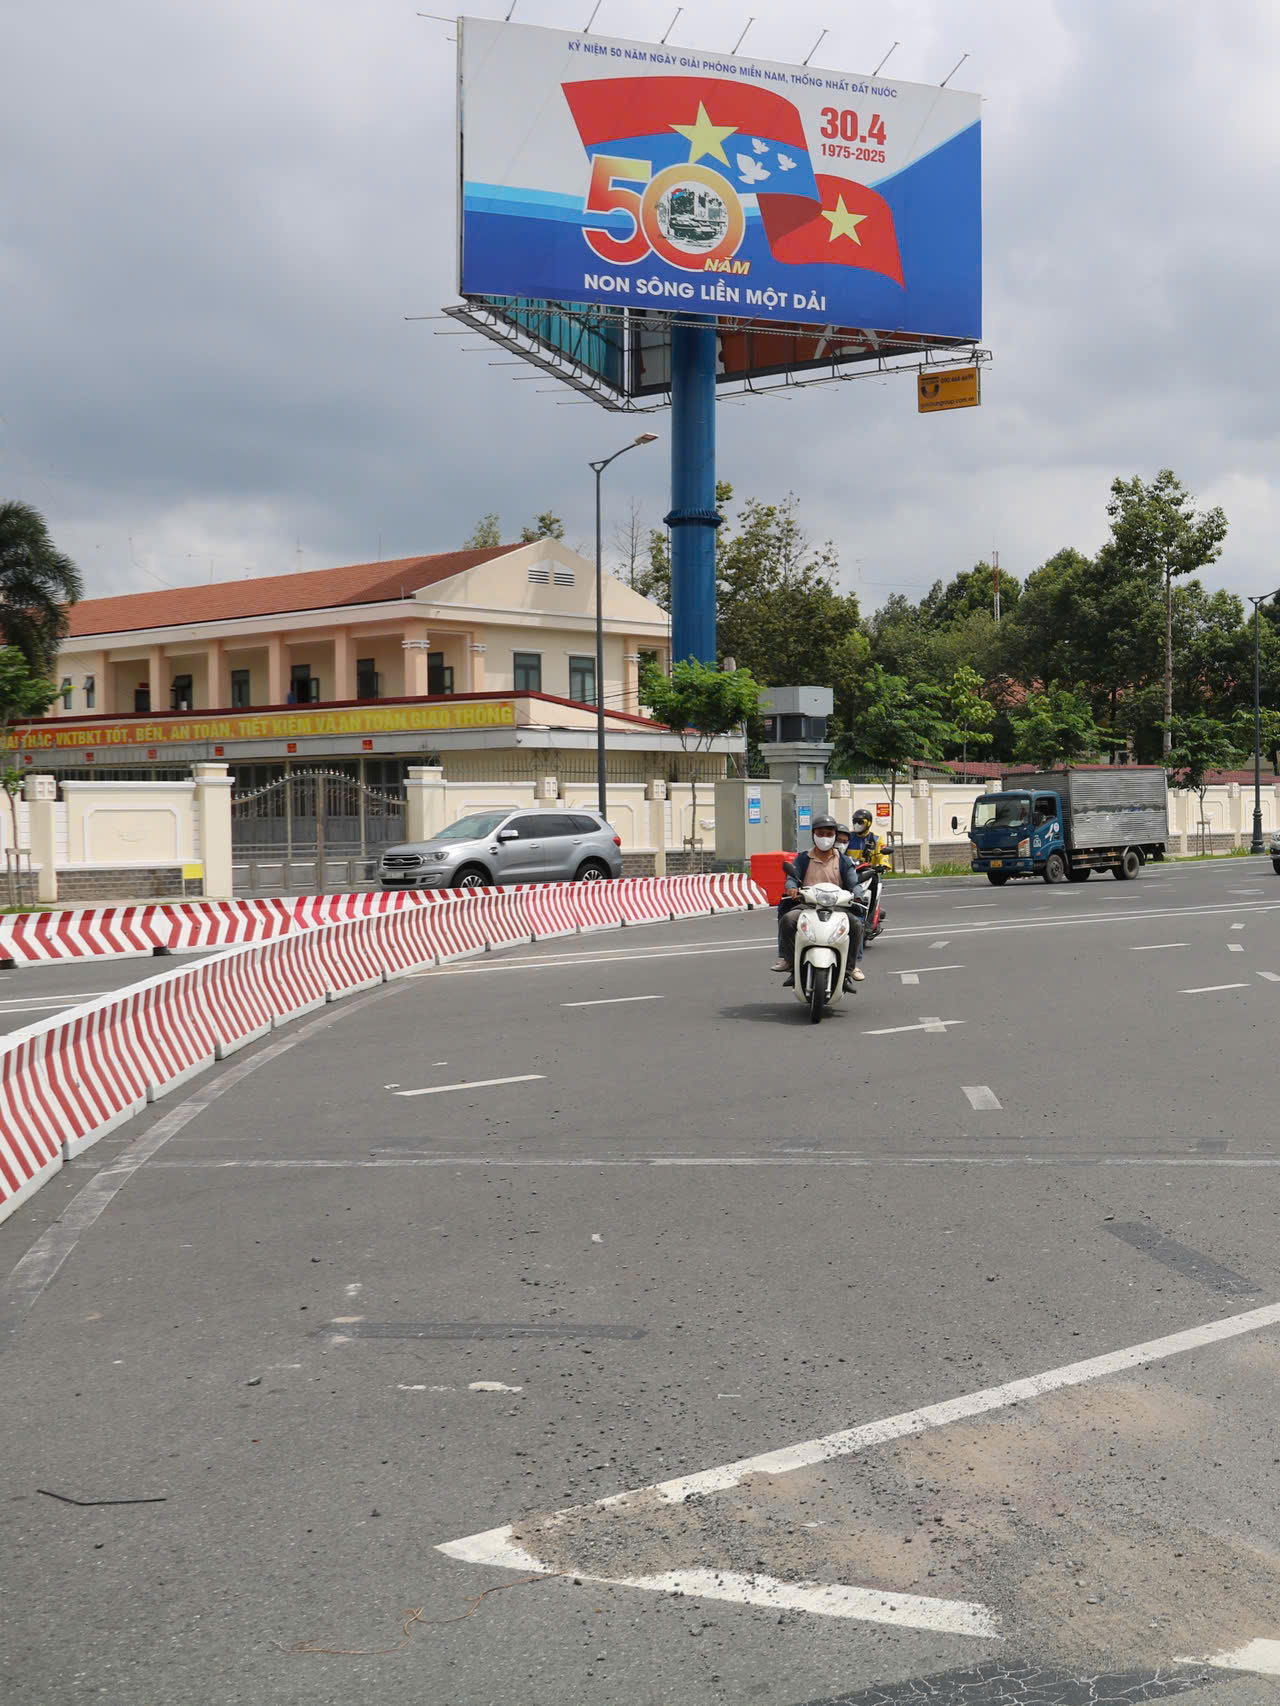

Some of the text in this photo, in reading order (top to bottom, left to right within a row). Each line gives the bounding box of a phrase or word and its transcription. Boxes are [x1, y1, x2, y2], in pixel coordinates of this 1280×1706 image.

[568, 39, 898, 98] KỶ NIỆM 50 NĂM NGÀY GIẢI PHÓNG MIỀN NAM, THỐNG NHẤT ĐẤT NƯỚC
[820, 107, 887, 145] 30.4
[821, 143, 886, 164] 1975-2025
[581, 153, 746, 272] 50
[703, 256, 751, 275] NĂM
[584, 273, 826, 311] NON SÔNG LIỀN MỘT DẢI
[171, 724, 190, 740] AN
[411, 709, 449, 729] GIAO
[454, 704, 513, 725] THÔNG
